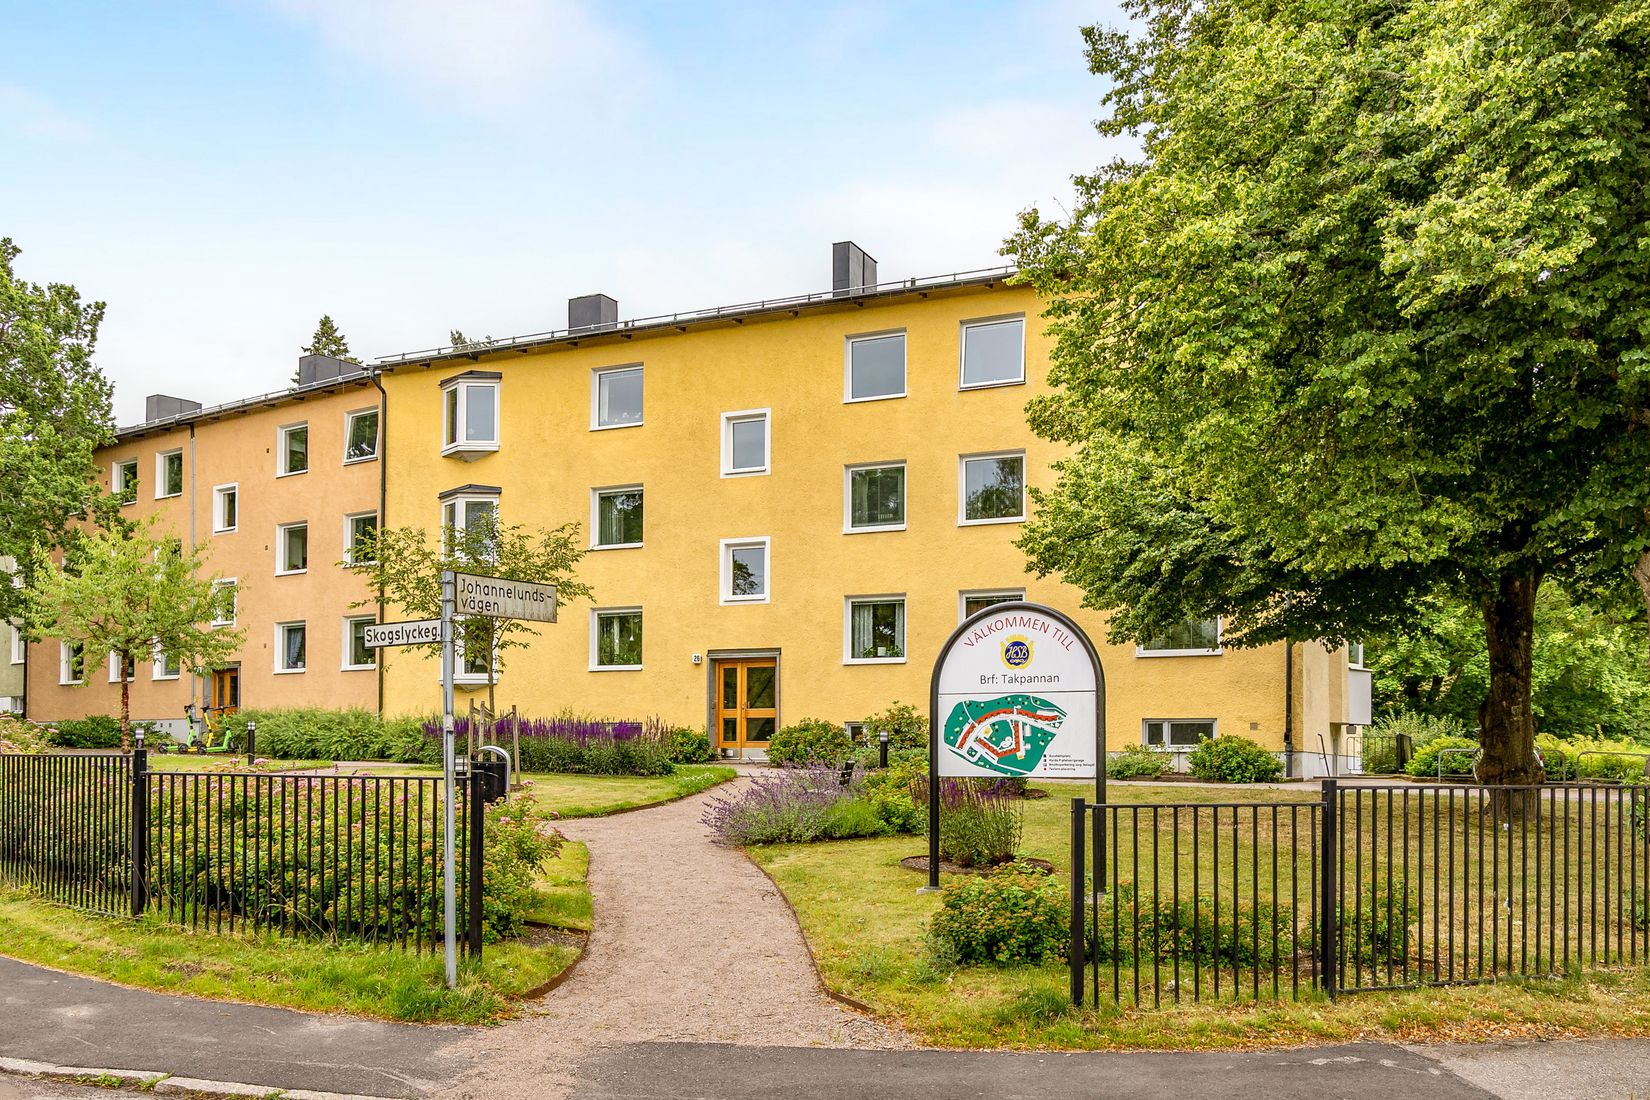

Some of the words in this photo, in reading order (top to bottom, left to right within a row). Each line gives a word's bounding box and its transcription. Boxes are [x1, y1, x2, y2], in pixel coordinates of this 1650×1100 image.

[460, 578, 552, 603] Johannelunds-
[461, 596, 500, 613] vägen
[365, 625, 441, 644] Skogslyckeg.
[963, 616, 1050, 648] VÄLKOMMEN
[1051, 627, 1075, 652] TILL
[1005, 645, 1028, 659] HSB
[980, 674, 998, 685] Brf:
[1001, 673, 1060, 685] Takpannan
